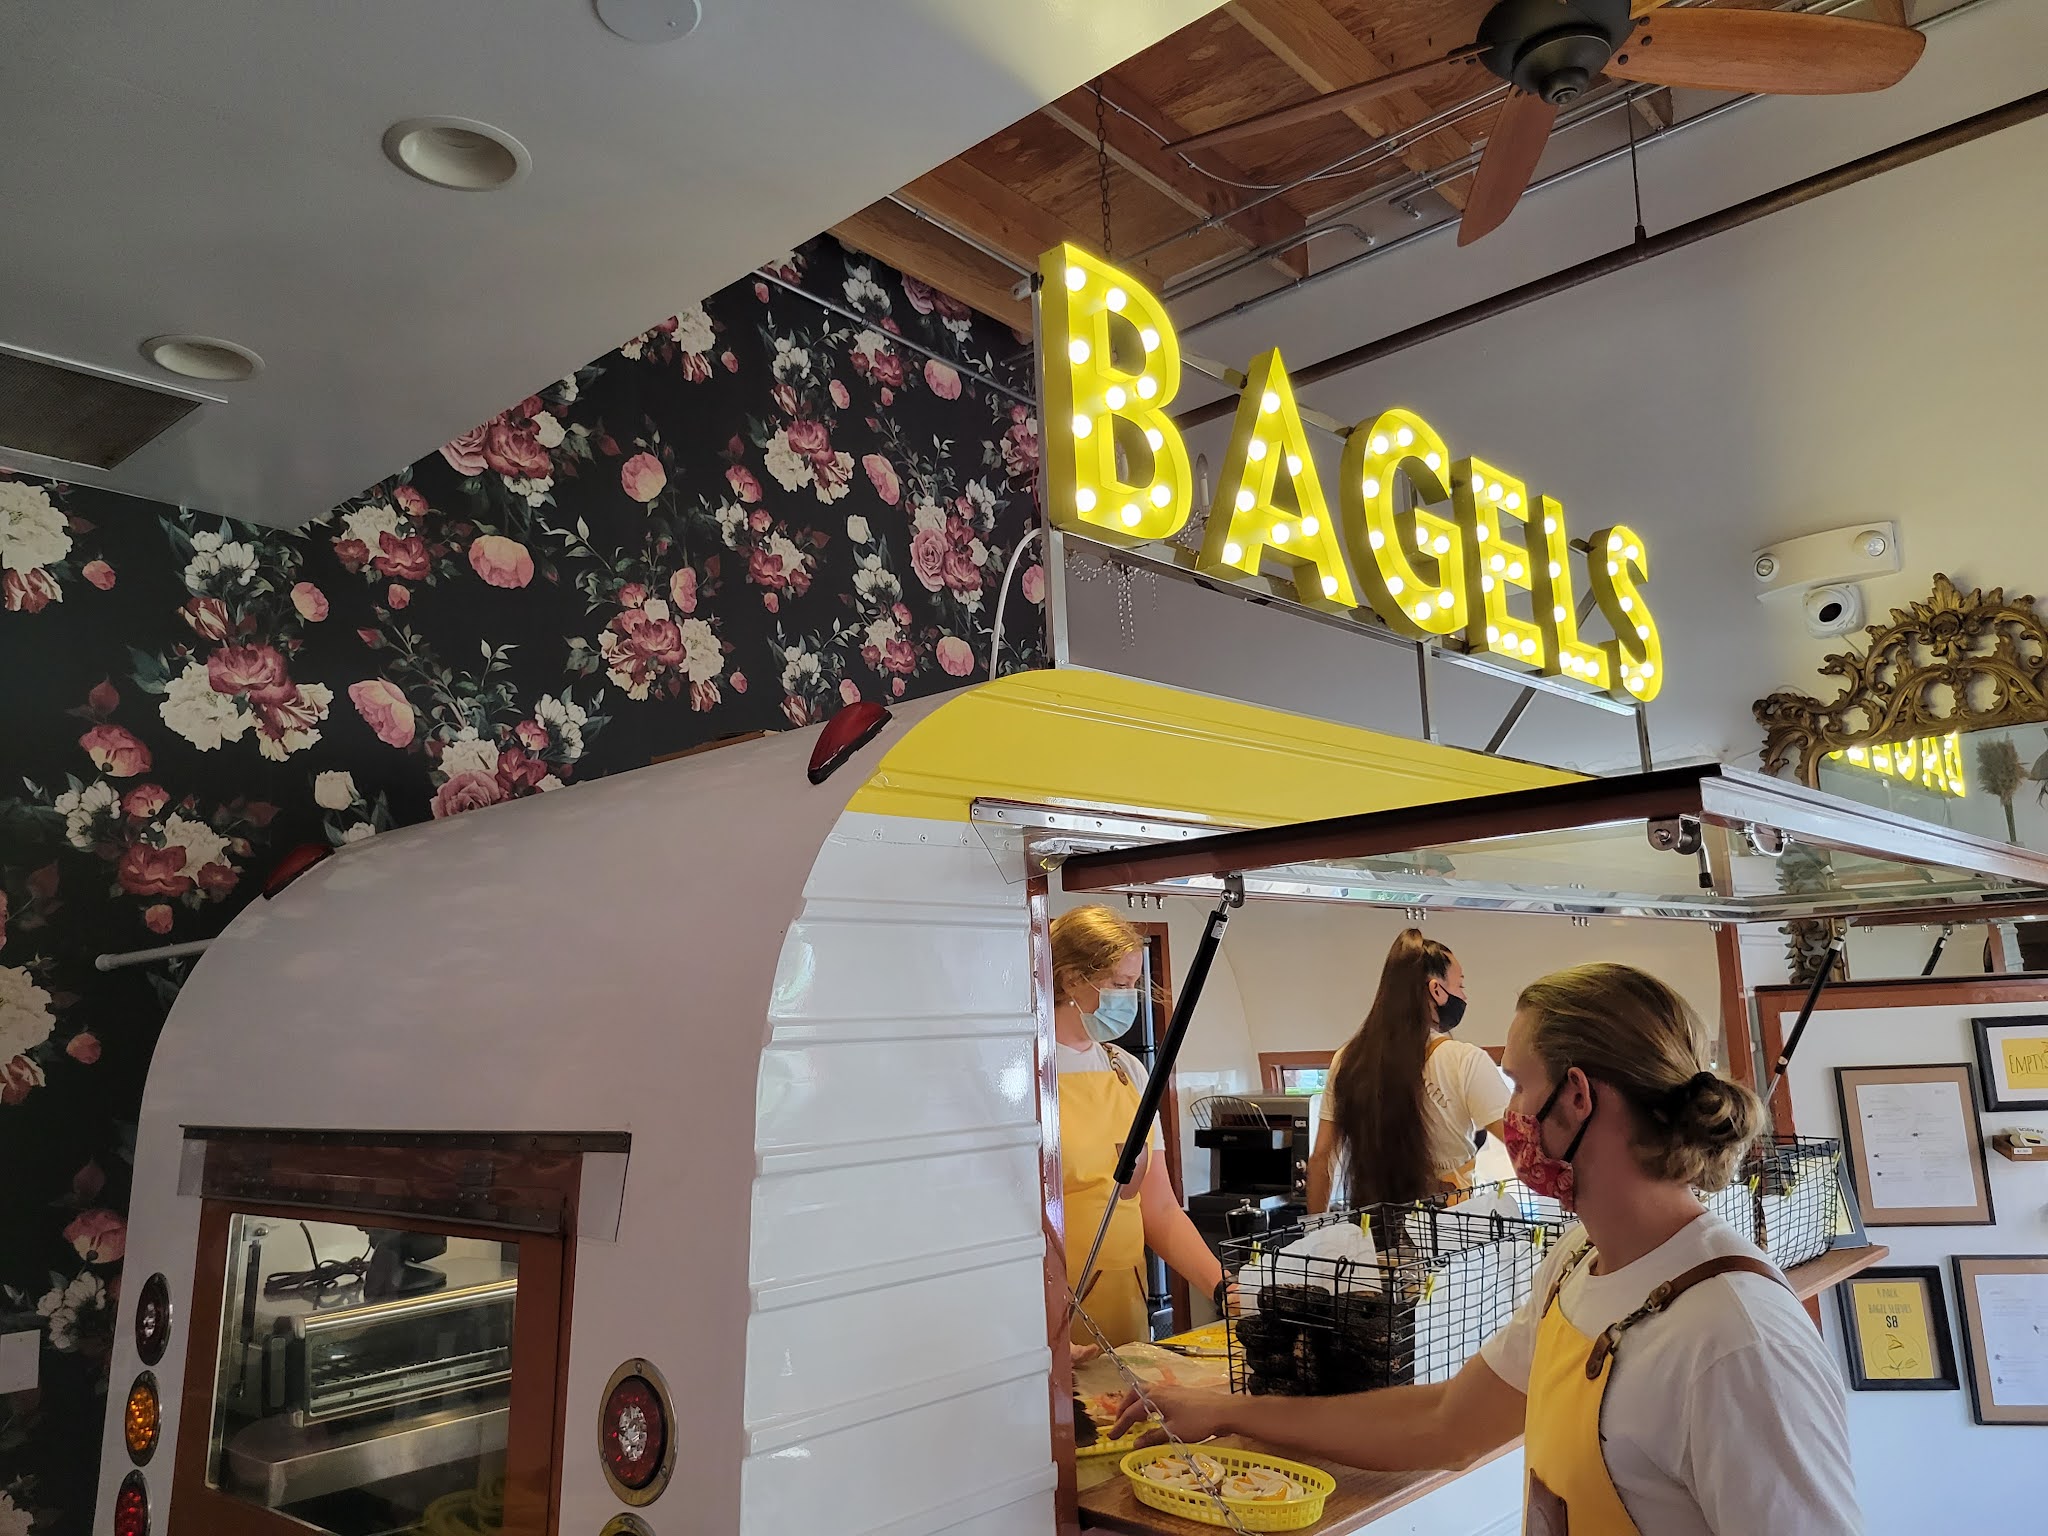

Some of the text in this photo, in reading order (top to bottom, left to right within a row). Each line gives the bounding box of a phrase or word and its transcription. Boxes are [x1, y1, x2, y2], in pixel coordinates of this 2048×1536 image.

[1039, 242, 1663, 702] BAGELS
[1424, 1080, 1451, 1108] GELS
[1868, 1303, 1887, 1314] BAGEL
